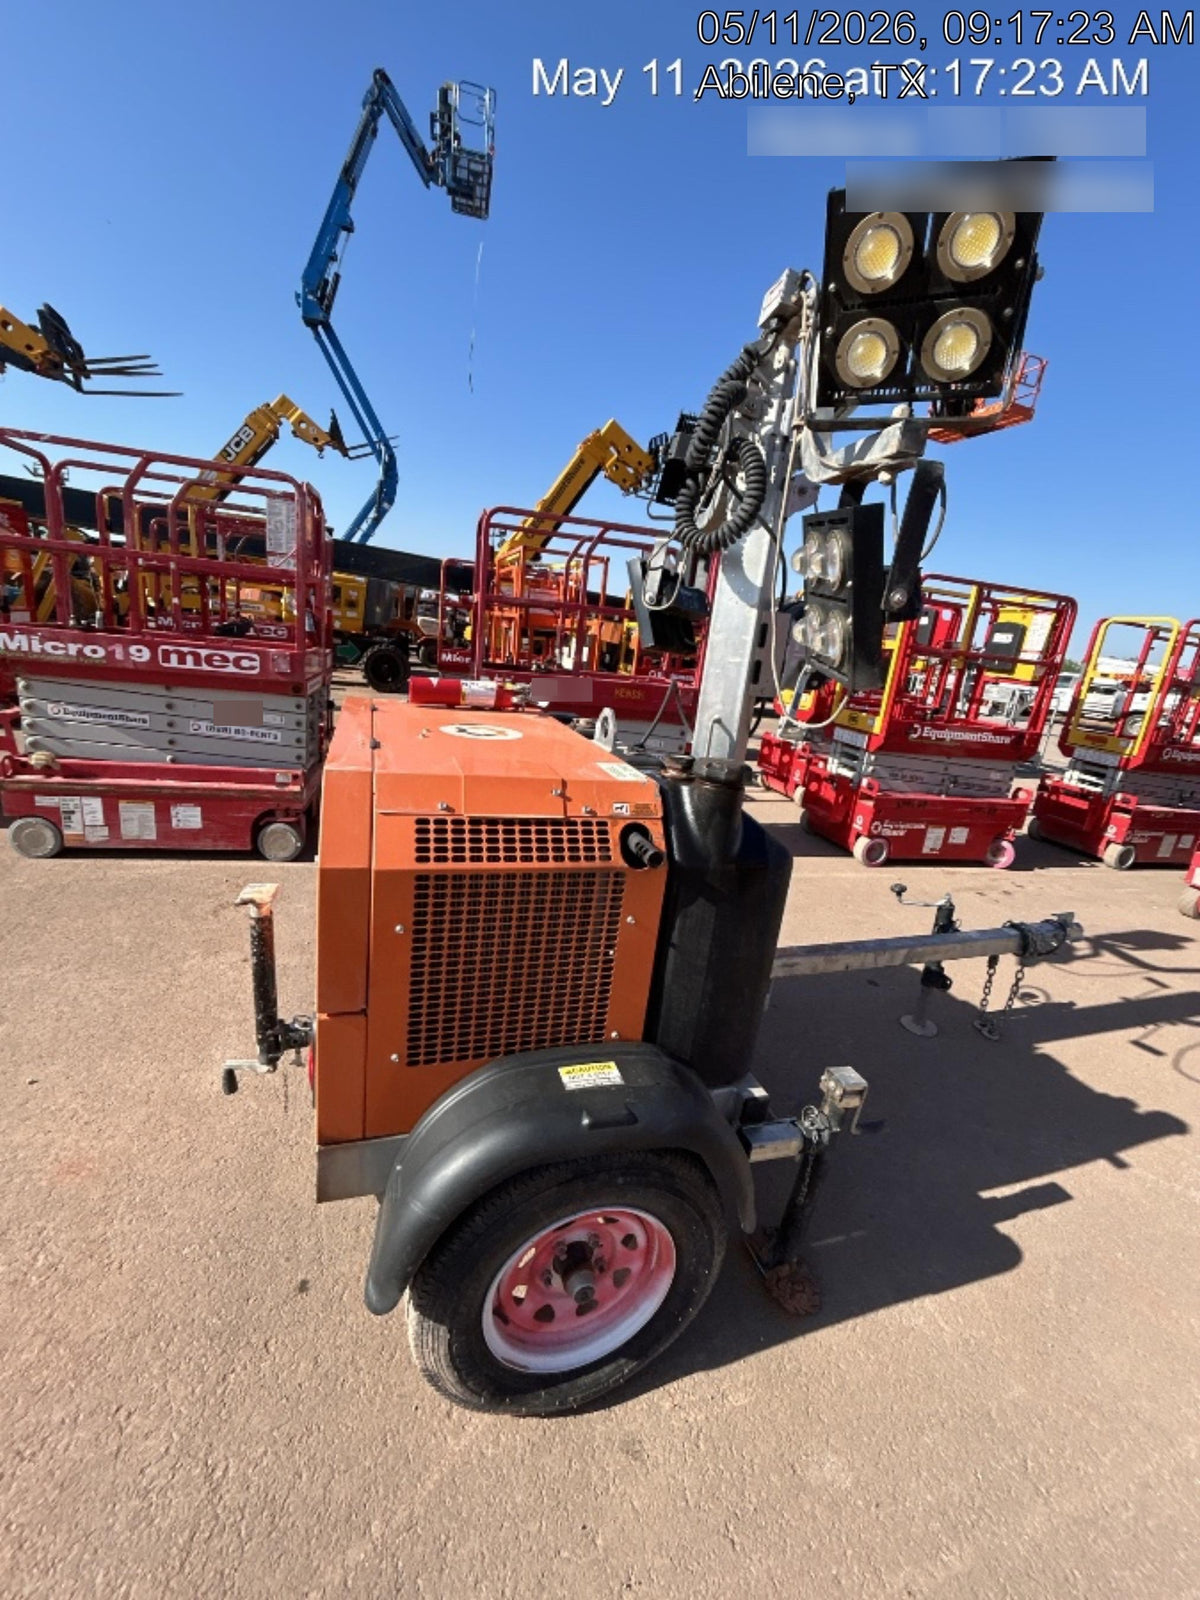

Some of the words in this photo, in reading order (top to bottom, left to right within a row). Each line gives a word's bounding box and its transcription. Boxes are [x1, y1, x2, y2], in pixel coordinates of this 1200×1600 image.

[225, 426, 255, 462] JCB
[160, 645, 260, 673] mec
[922, 726, 1012, 744] EquipmentShare
